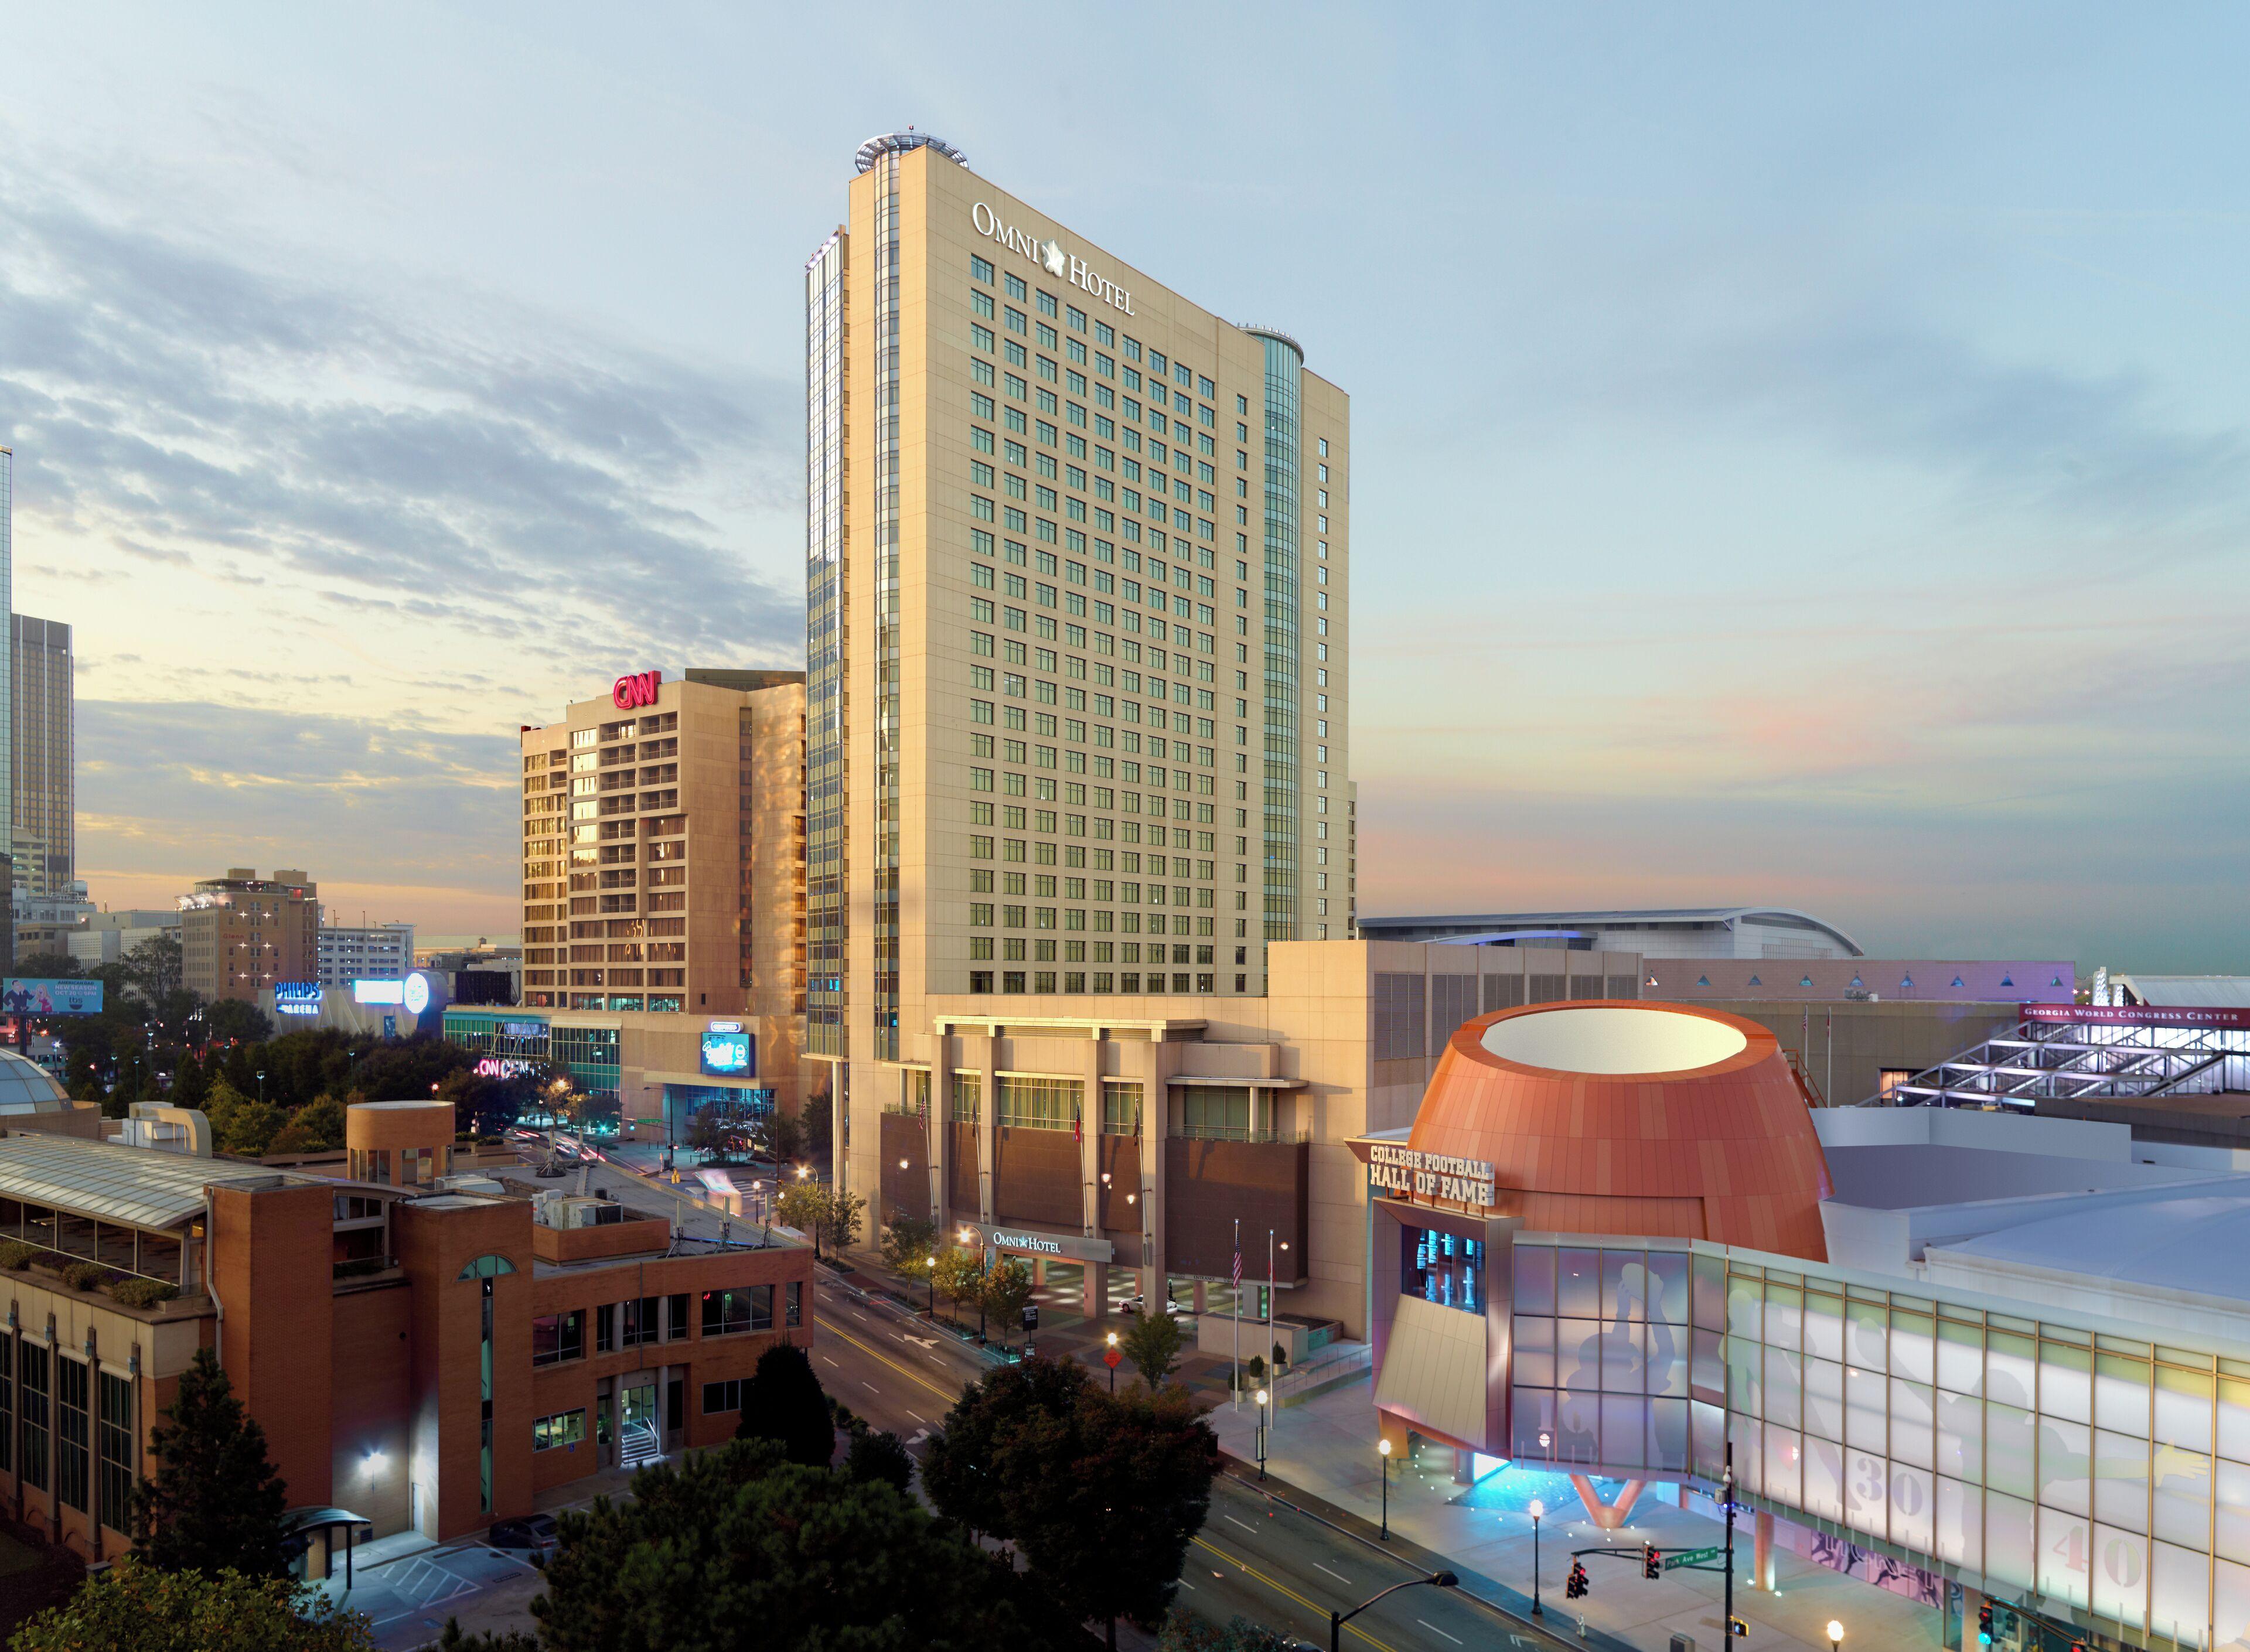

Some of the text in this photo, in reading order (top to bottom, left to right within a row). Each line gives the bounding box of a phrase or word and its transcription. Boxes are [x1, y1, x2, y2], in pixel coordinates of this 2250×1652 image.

[973, 202, 1135, 316] OMNI HOTEL
[613, 670, 659, 709] CNN
[275, 982, 321, 999] PHILIPS
[289, 1004, 319, 1014] ARENA
[2024, 1008, 2238, 1020] GEORGIA WORLD CONGRESS CENTER
[479, 1059, 499, 1076] CNN
[1371, 1145, 1492, 1180] COLLEGE FOOTBALL
[1370, 1163, 1492, 1207] HALL OF FAME
[993, 1232, 1061, 1253] OMNI HOTEL
[1856, 1457, 1923, 1517] 30
[1696, 1551, 1708, 1559] West
[2053, 1525, 2142, 1588] 40
